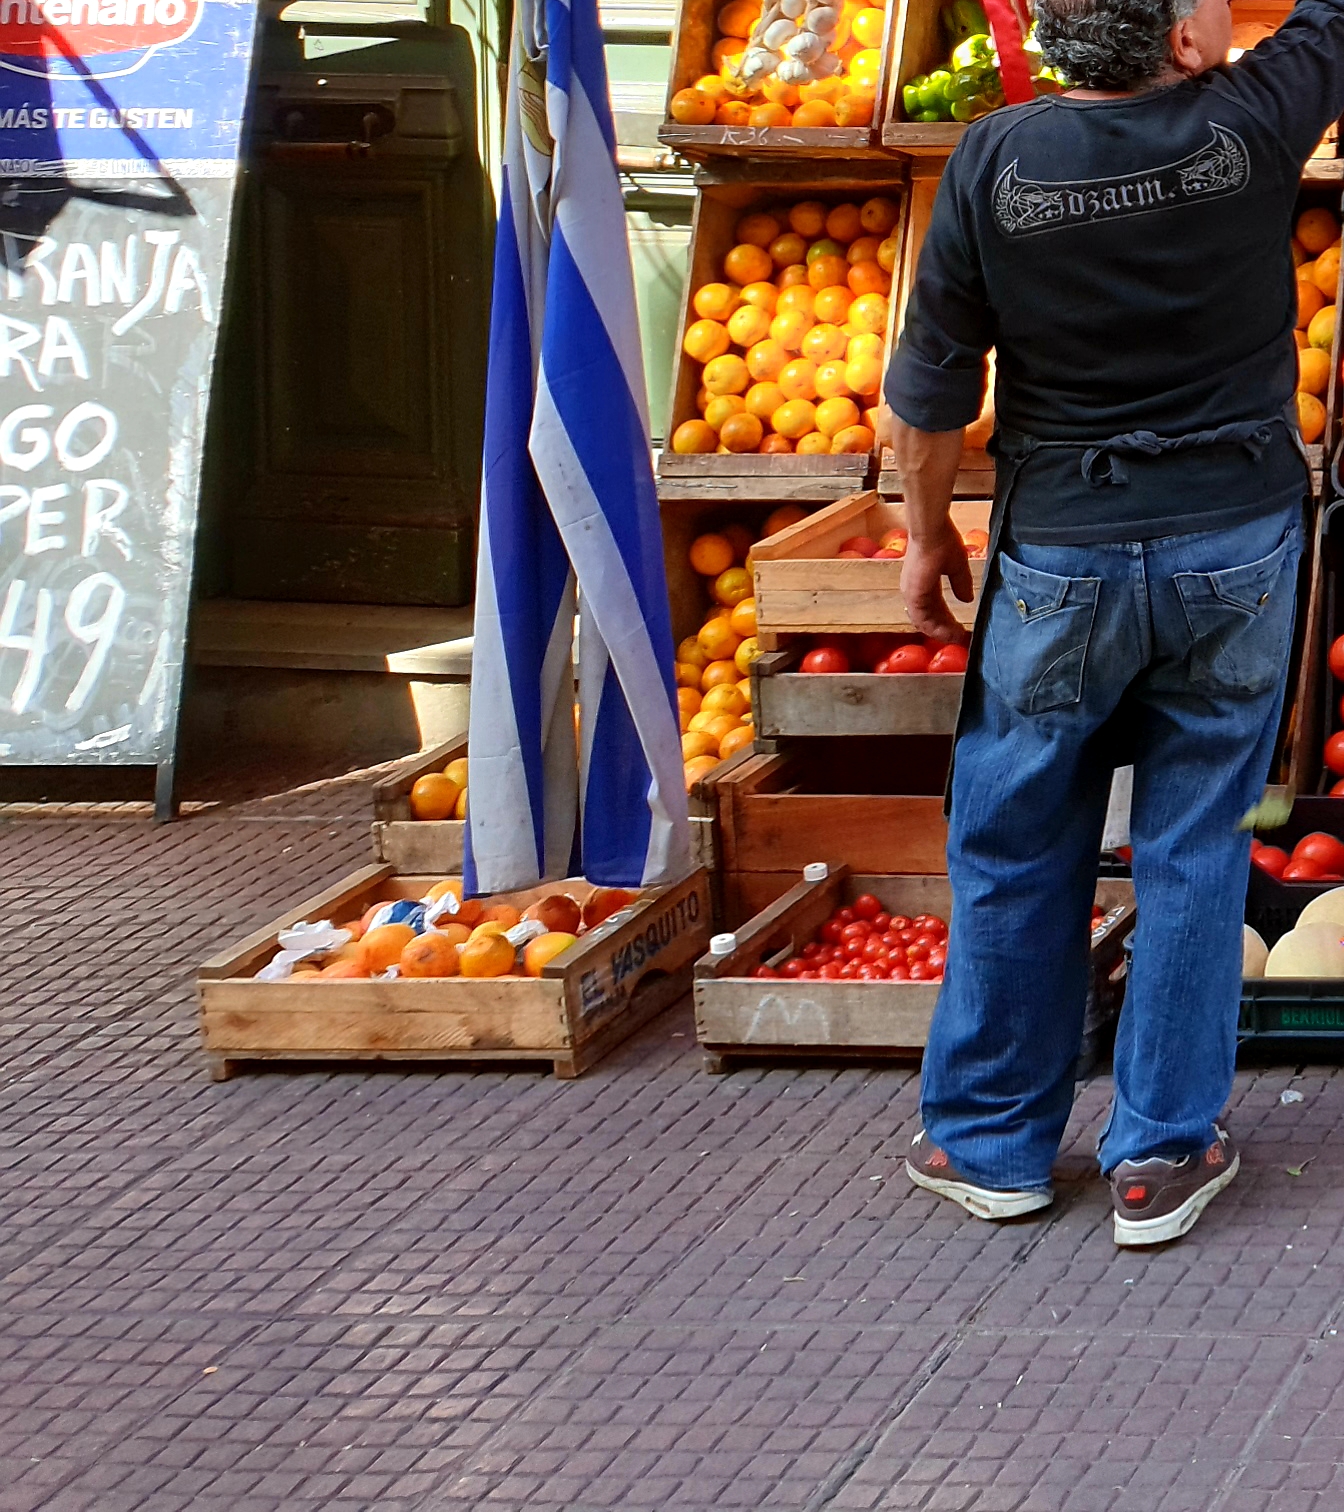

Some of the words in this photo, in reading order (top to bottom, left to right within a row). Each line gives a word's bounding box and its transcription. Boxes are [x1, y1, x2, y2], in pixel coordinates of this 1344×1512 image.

[53, 108, 86, 129] TE
[89, 108, 193, 129] GUSTEN
[0, 402, 118, 472] GO
